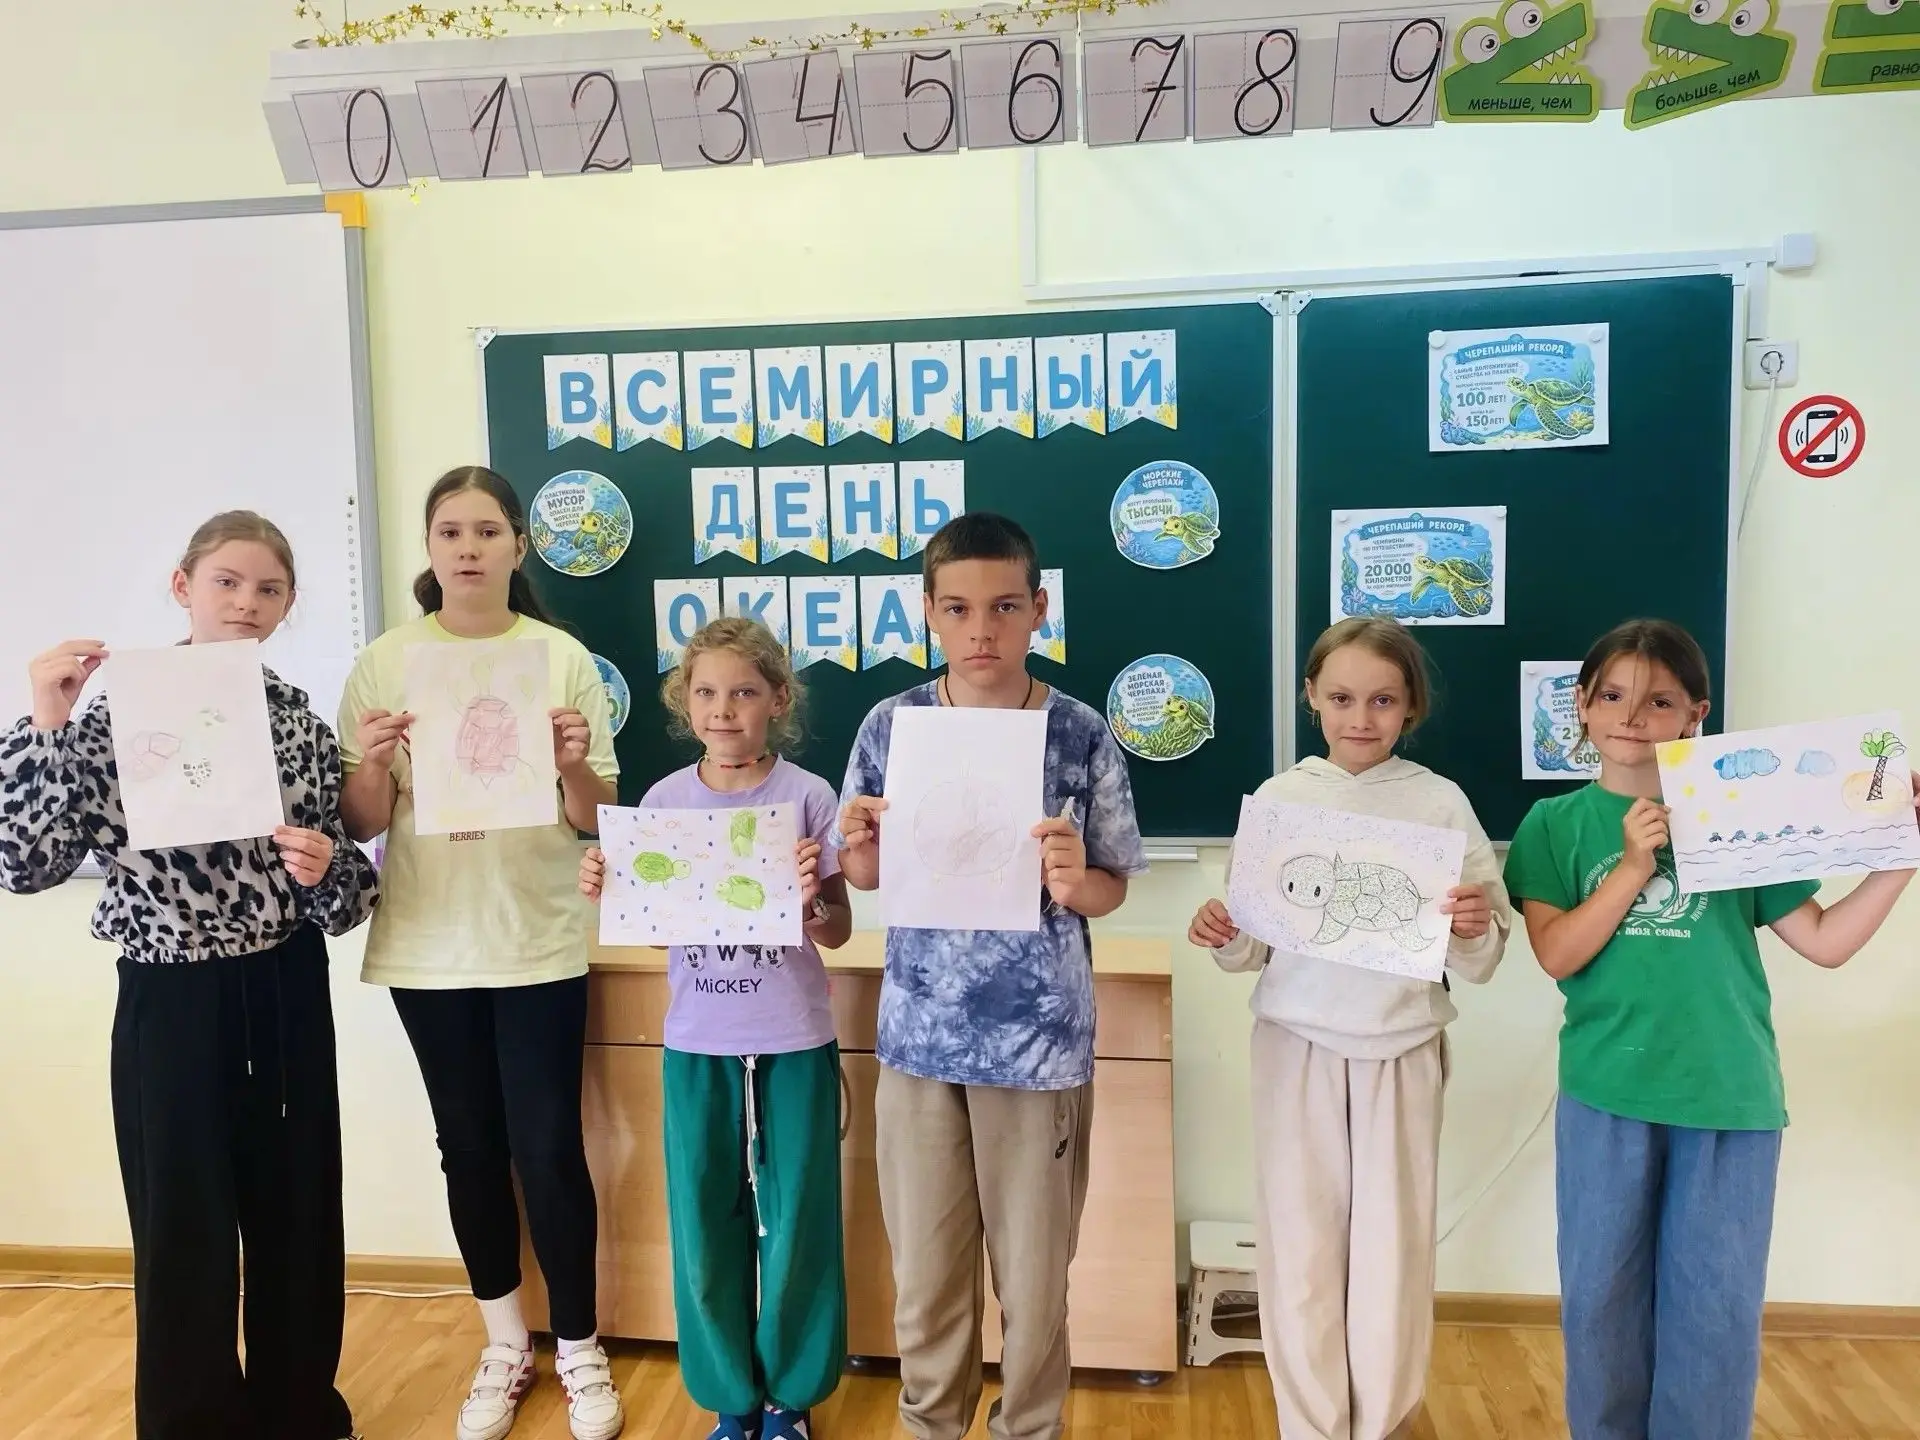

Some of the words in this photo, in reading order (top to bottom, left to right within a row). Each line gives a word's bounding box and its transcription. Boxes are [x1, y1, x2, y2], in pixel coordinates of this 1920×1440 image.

[1870, 62, 1920, 82] равно
[1655, 82, 1723, 111] больше,
[1727, 69, 1761, 88] чем
[346, 87, 392, 189] 0
[469, 76, 508, 179] 1
[571, 70, 631, 174] 2
[696, 62, 749, 165] 3
[795, 53, 843, 156] 4
[902, 48, 955, 152] 5
[1008, 39, 1063, 144] 6
[1129, 34, 1186, 142] 7
[1234, 28, 1297, 137] 8
[1370, 17, 1443, 127] 9
[1467, 96, 1535, 112] меньше,
[1540, 96, 1573, 110] чем
[1464, 343, 1525, 358] ЧЕРЕПАШИЙ
[1528, 342, 1566, 354] РЕКОРД
[559, 348, 1162, 426] ВСЕМИРНЫЙ
[1456, 391, 1486, 408] 100
[1488, 394, 1507, 404] ЛЕТ!
[1465, 414, 1489, 428] 150
[1489, 417, 1505, 425] ЛЕТ!
[1141, 478, 1185, 489] ЧЕРЕПАХИ
[1142, 469, 1183, 482] МОРСКИЕ
[547, 494, 586, 511] МУСОР
[705, 478, 951, 541] ДЕНЬ
[1126, 504, 1174, 520] ТЫСЯЧИ
[1367, 519, 1424, 535] ЧЕРЕПАШИЙ
[1429, 520, 1466, 533] РЕКОРД
[1364, 564, 1383, 577] 20
[1384, 562, 1412, 576] 000
[1364, 575, 1413, 585] КИЛОМЕТРОВ
[1127, 679, 1165, 691] МОРСКАЯ
[1127, 687, 1167, 698] ЧЕРЕПАХА
[1562, 727, 1571, 740] 2
[1574, 751, 1601, 765] 600
[449, 830, 487, 842] BERRIES
